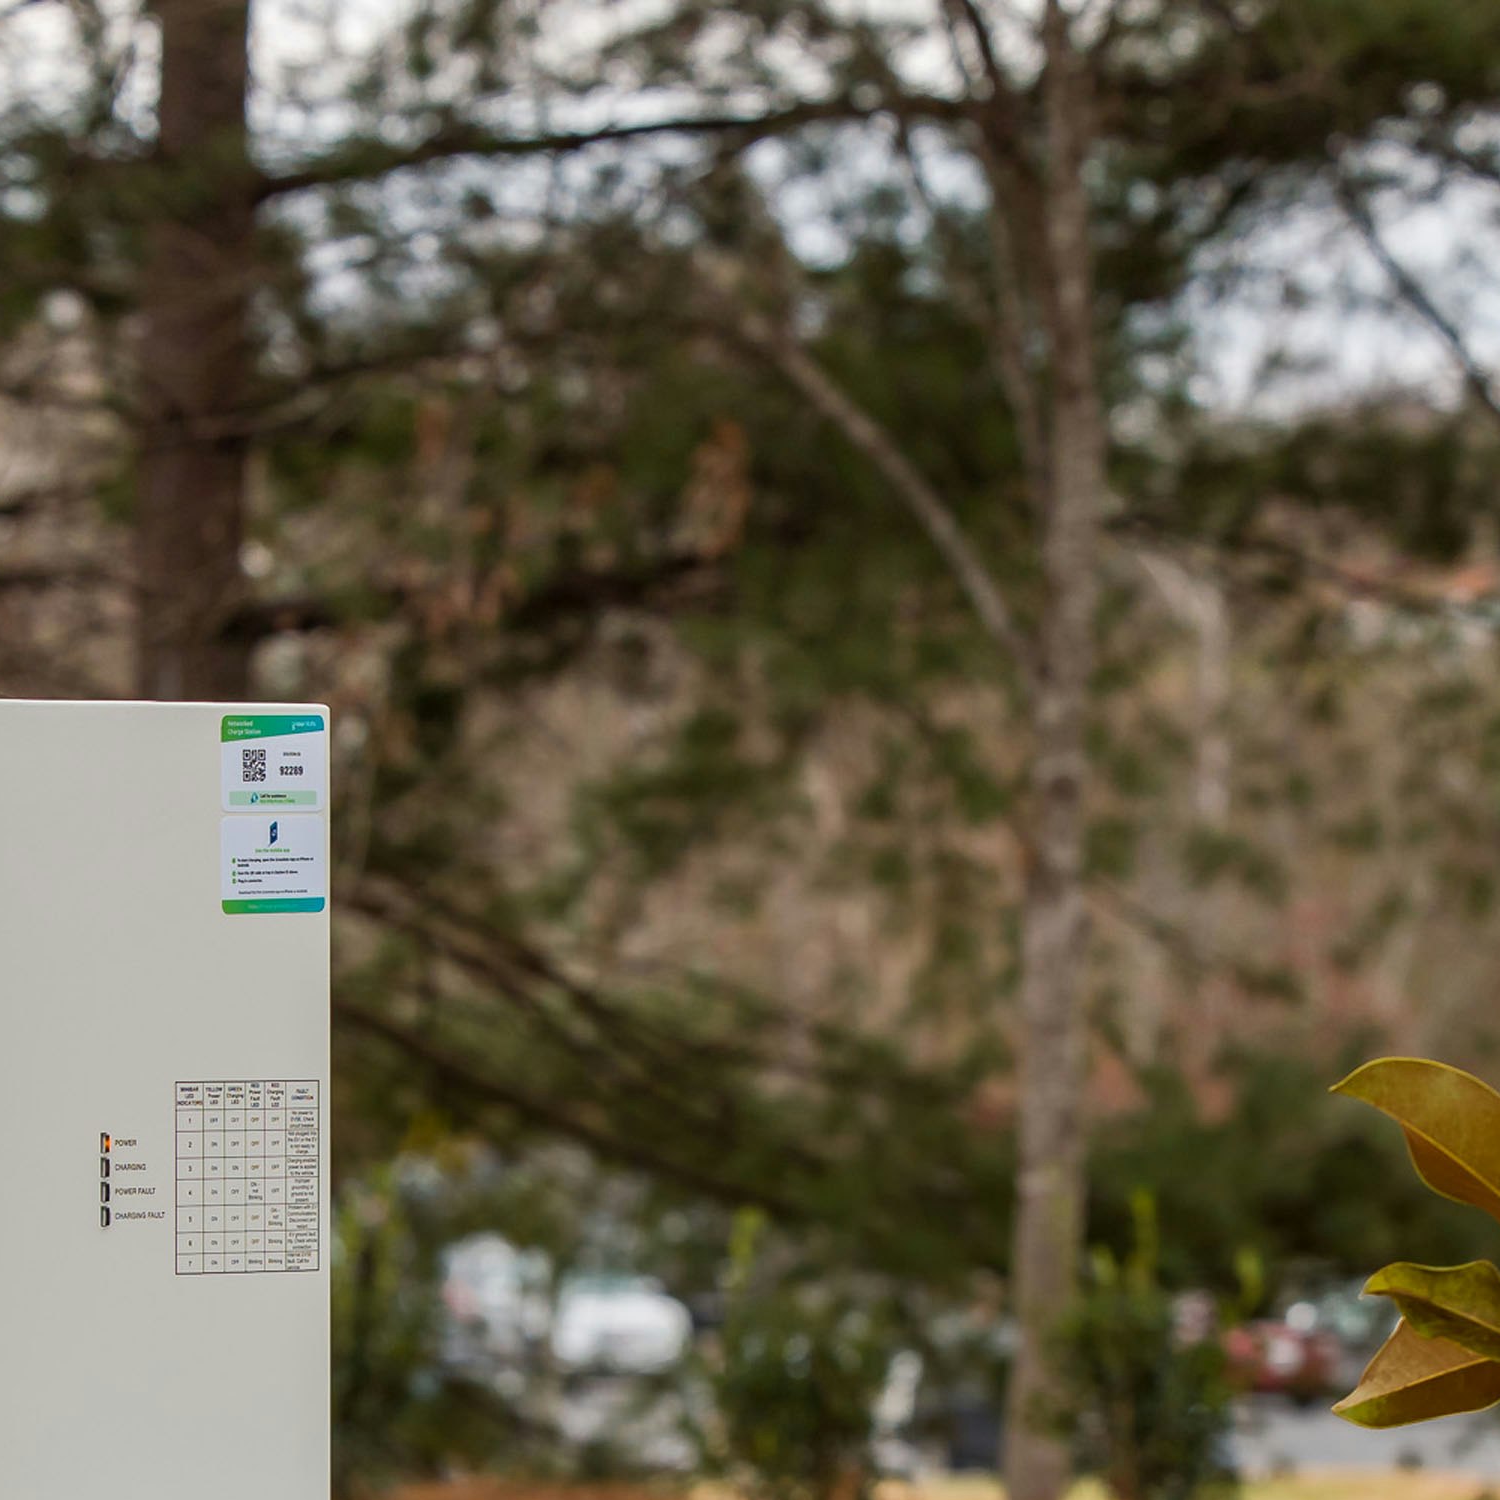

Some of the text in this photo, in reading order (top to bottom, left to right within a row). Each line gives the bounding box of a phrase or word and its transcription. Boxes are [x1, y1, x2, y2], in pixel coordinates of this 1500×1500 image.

[114, 1139, 137, 1147] POWER
[114, 1163, 147, 1171] CHARGING
[114, 1187, 156, 1196] POWER FAULT
[115, 1211, 165, 1220] CHARGING FAULT
